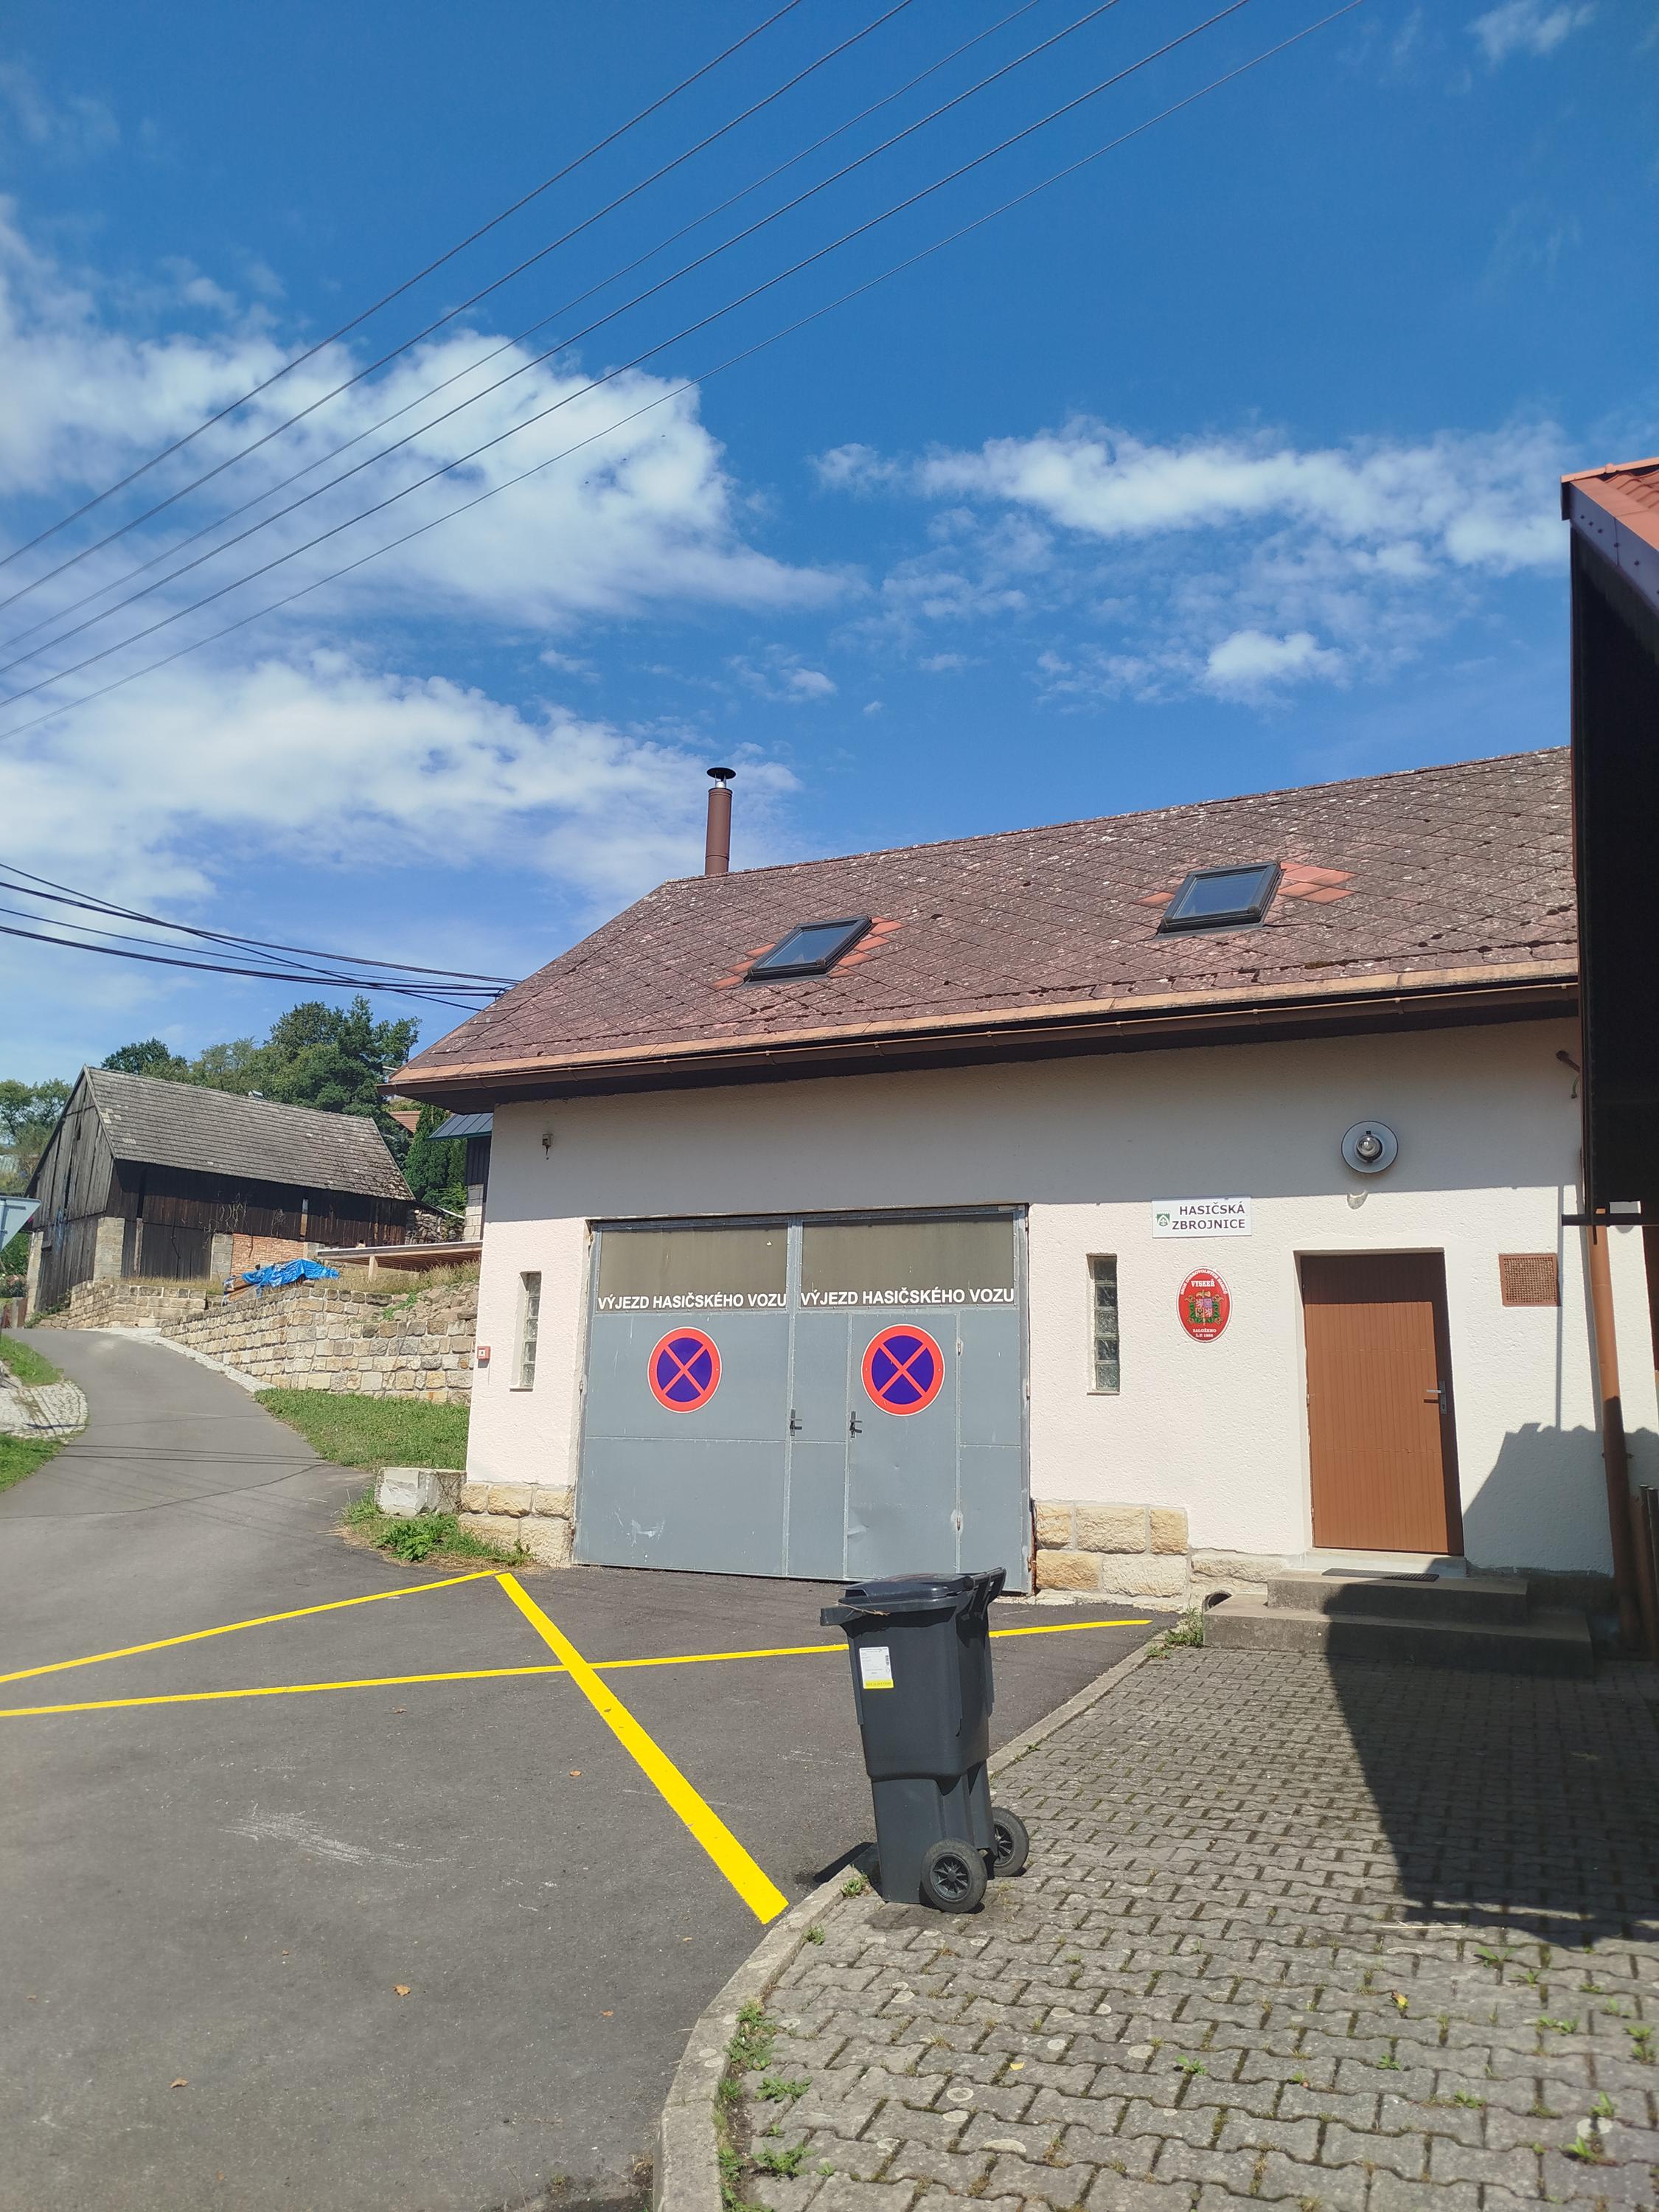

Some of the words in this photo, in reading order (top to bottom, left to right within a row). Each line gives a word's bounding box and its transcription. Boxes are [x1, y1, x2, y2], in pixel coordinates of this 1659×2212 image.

[1180, 1201, 1245, 1215] HASIČSKÁ
[1172, 1219, 1245, 1230] ZBROJNICE
[598, 1294, 650, 1310] VÝJEZD
[653, 1292, 744, 1309] HASIČSKÉHO
[747, 1293, 787, 1307] VOZU
[801, 1290, 858, 1305] VÝJEZD
[863, 1287, 964, 1304] HASIČSKÉHO
[969, 1288, 1015, 1303] VOZU
